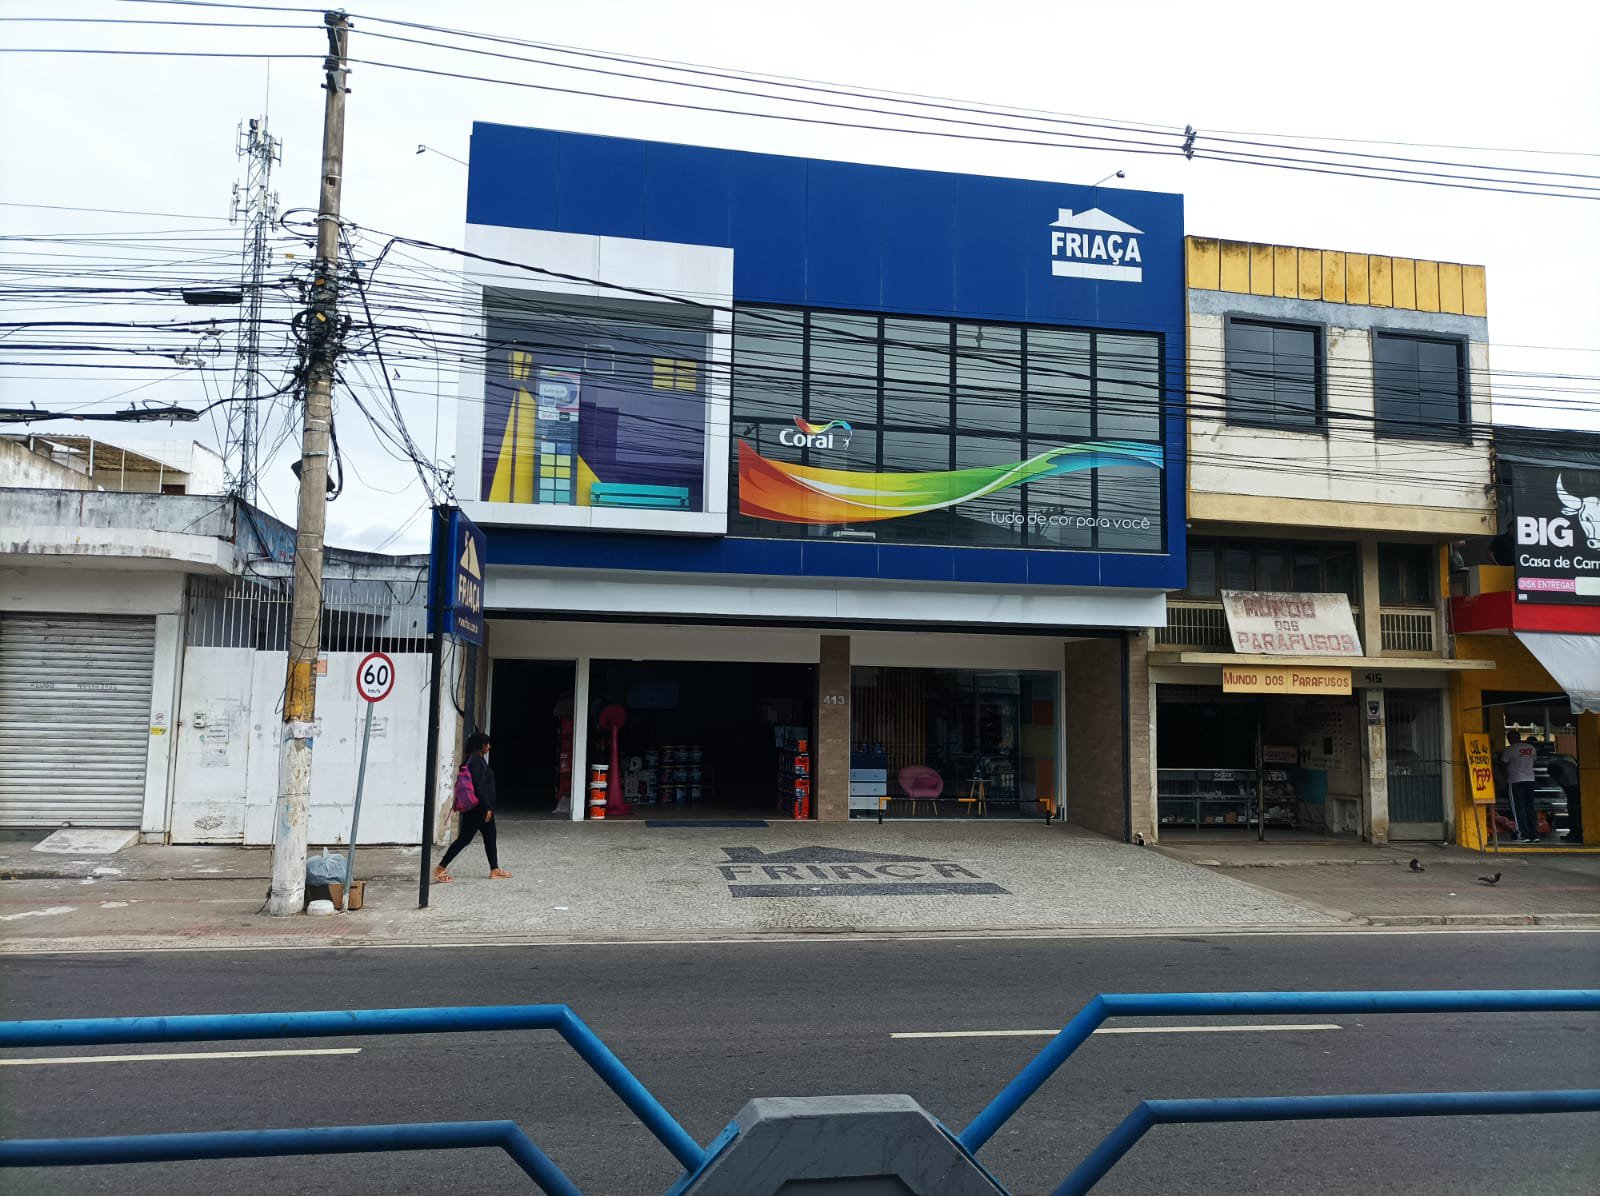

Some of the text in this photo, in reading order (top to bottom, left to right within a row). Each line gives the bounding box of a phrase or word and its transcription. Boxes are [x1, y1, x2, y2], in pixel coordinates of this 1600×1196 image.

[1051, 231, 1142, 265] FRIAÇA
[779, 429, 834, 449] Coral
[991, 511, 1150, 530] tudo de cor para você
[1517, 516, 1574, 547] BIG
[1520, 554, 1551, 567] Casa
[1554, 556, 1570, 568] de
[458, 573, 480, 614] FRIAÇA
[1520, 580, 1575, 590] DISK ENTREGAS
[1236, 632, 1356, 653] PARAFUSOS
[364, 664, 389, 686] 60
[1365, 673, 1383, 683] 415
[823, 696, 845, 705] 413
